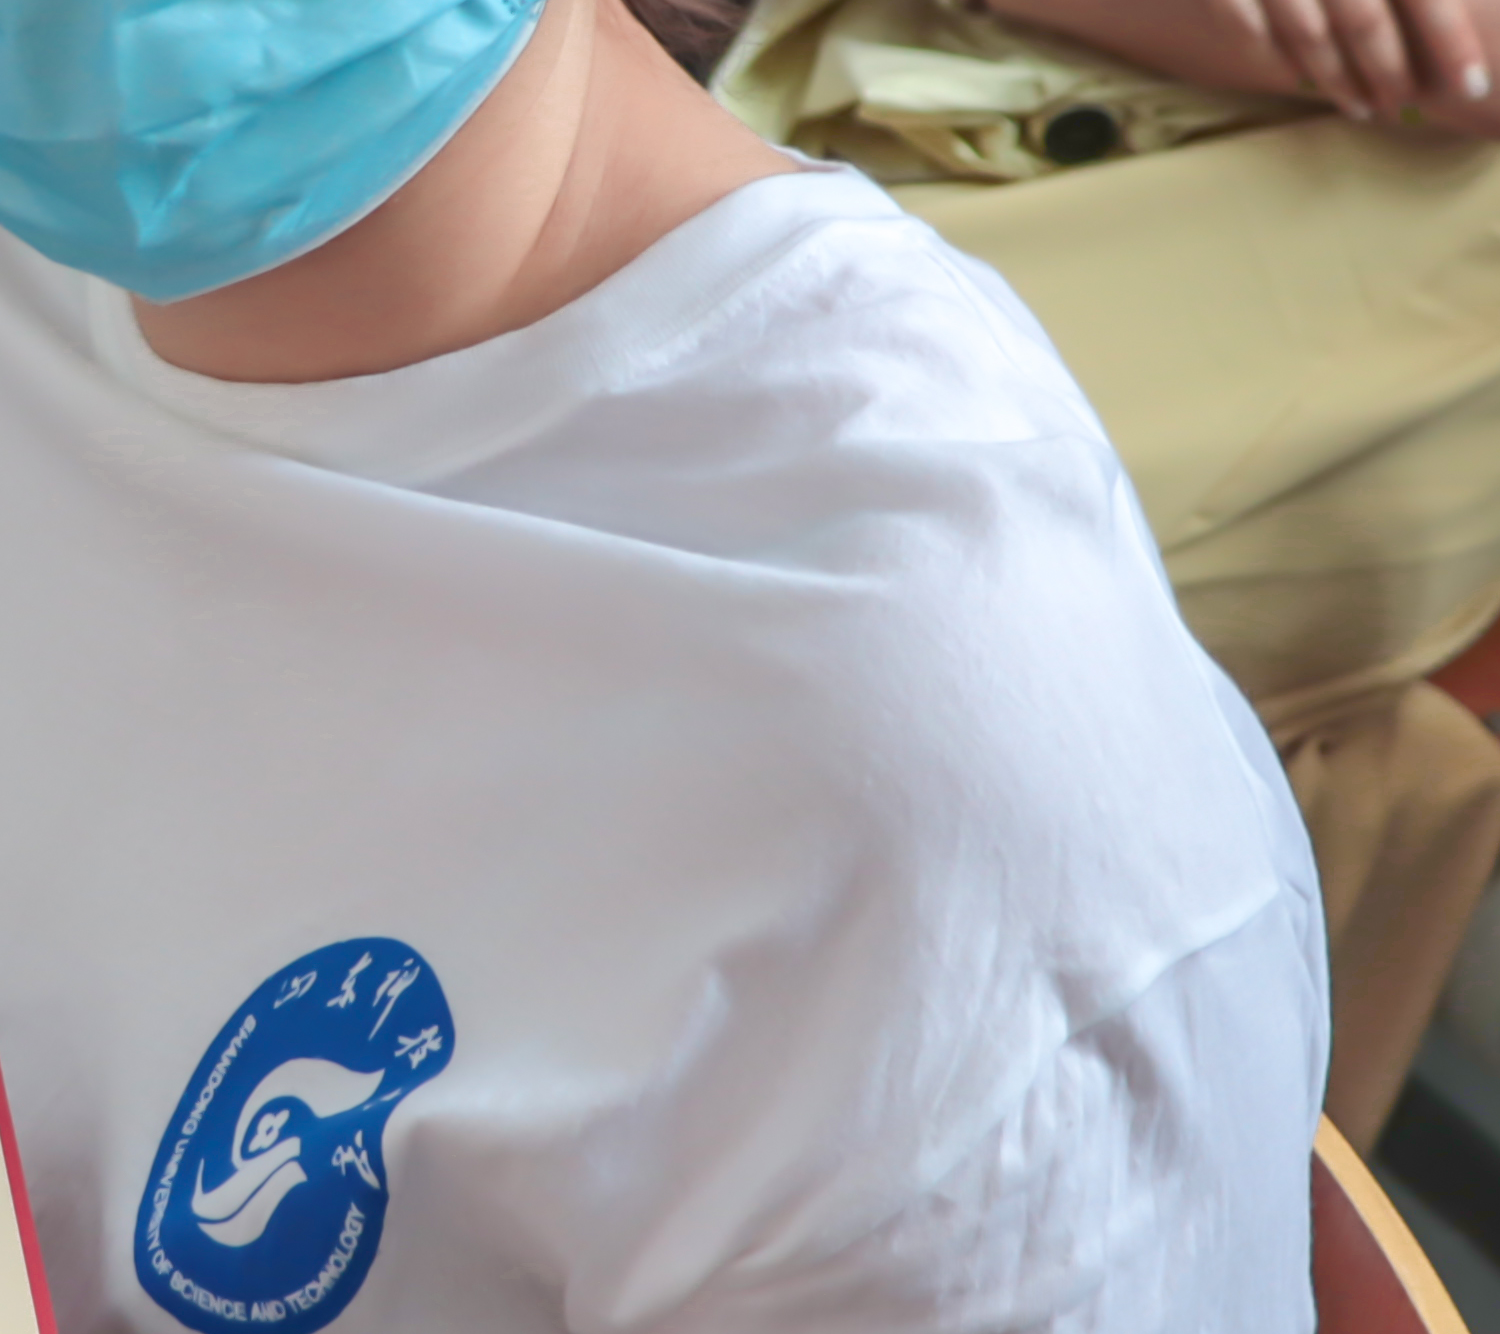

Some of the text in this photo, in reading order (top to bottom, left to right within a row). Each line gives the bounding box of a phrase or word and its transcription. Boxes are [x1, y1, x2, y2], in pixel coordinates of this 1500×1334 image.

[182, 1014, 257, 1135] SHANDONG
[169, 1269, 247, 1322] SCIENCE
[250, 1300, 286, 1322] AND
